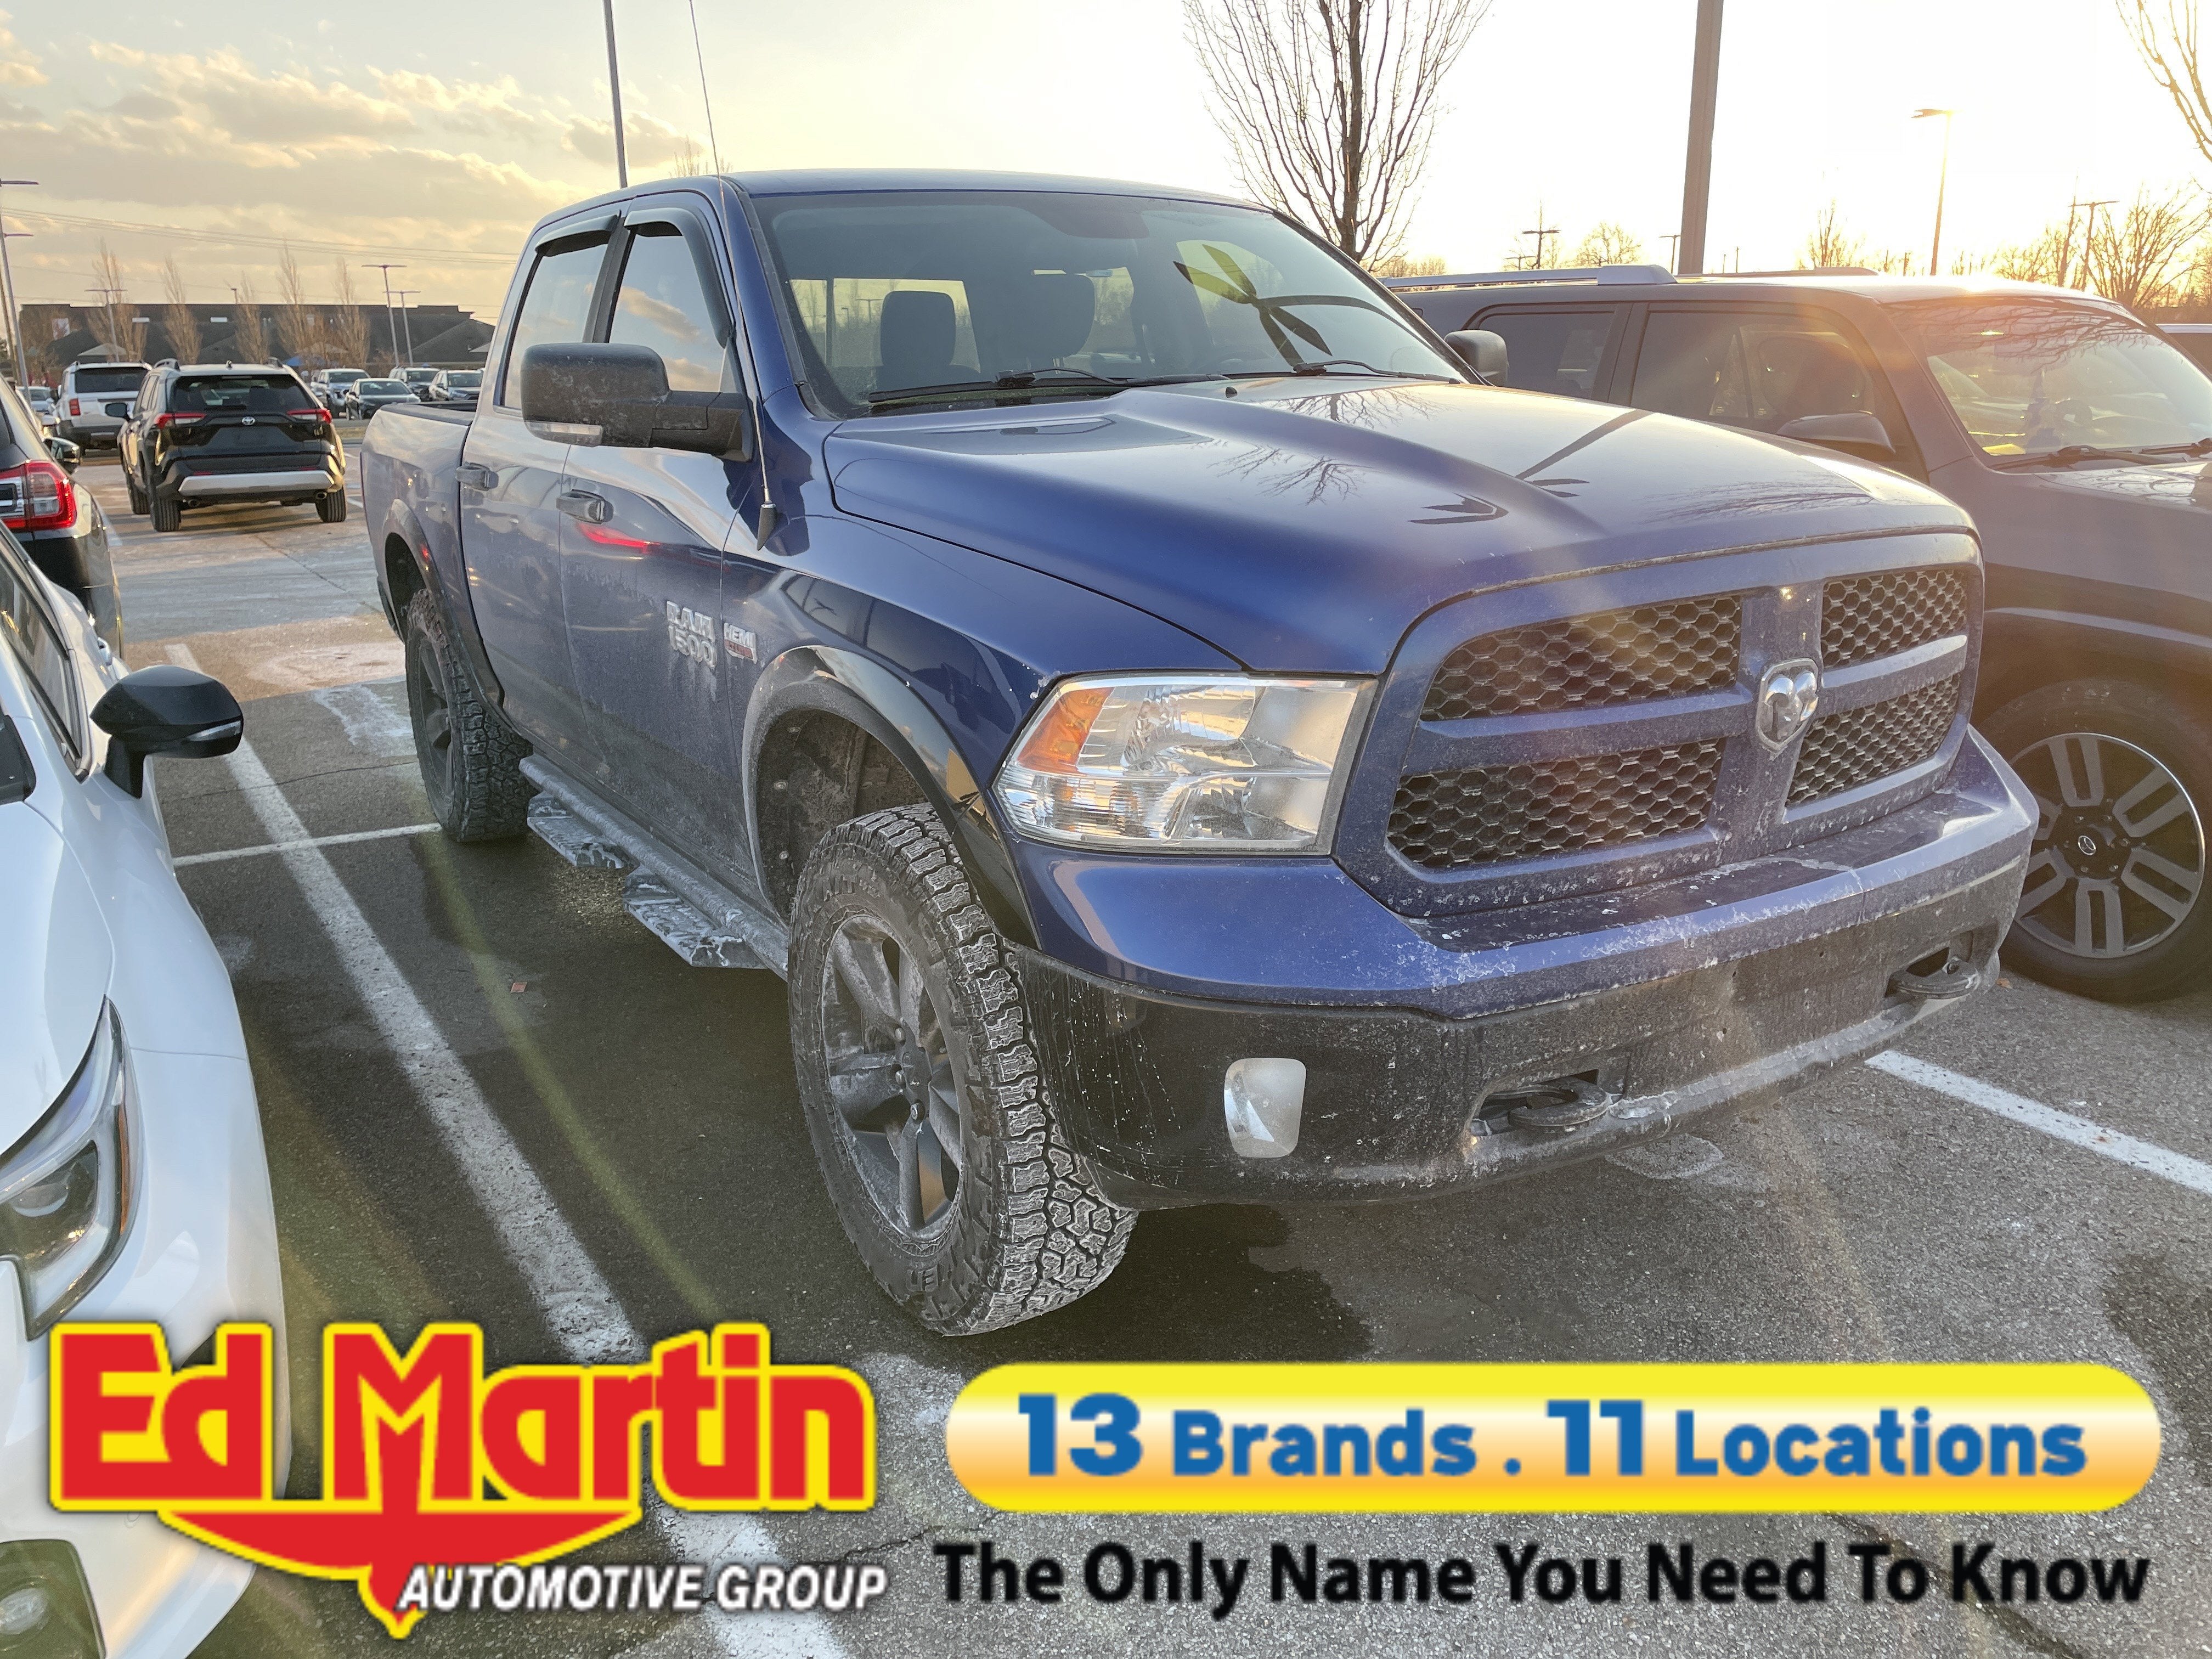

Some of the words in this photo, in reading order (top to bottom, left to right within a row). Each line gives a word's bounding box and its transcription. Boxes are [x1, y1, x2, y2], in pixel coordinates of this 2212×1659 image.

[667, 601, 716, 644] RAM
[724, 622, 757, 649] HEMI
[668, 625, 718, 668] 1500
